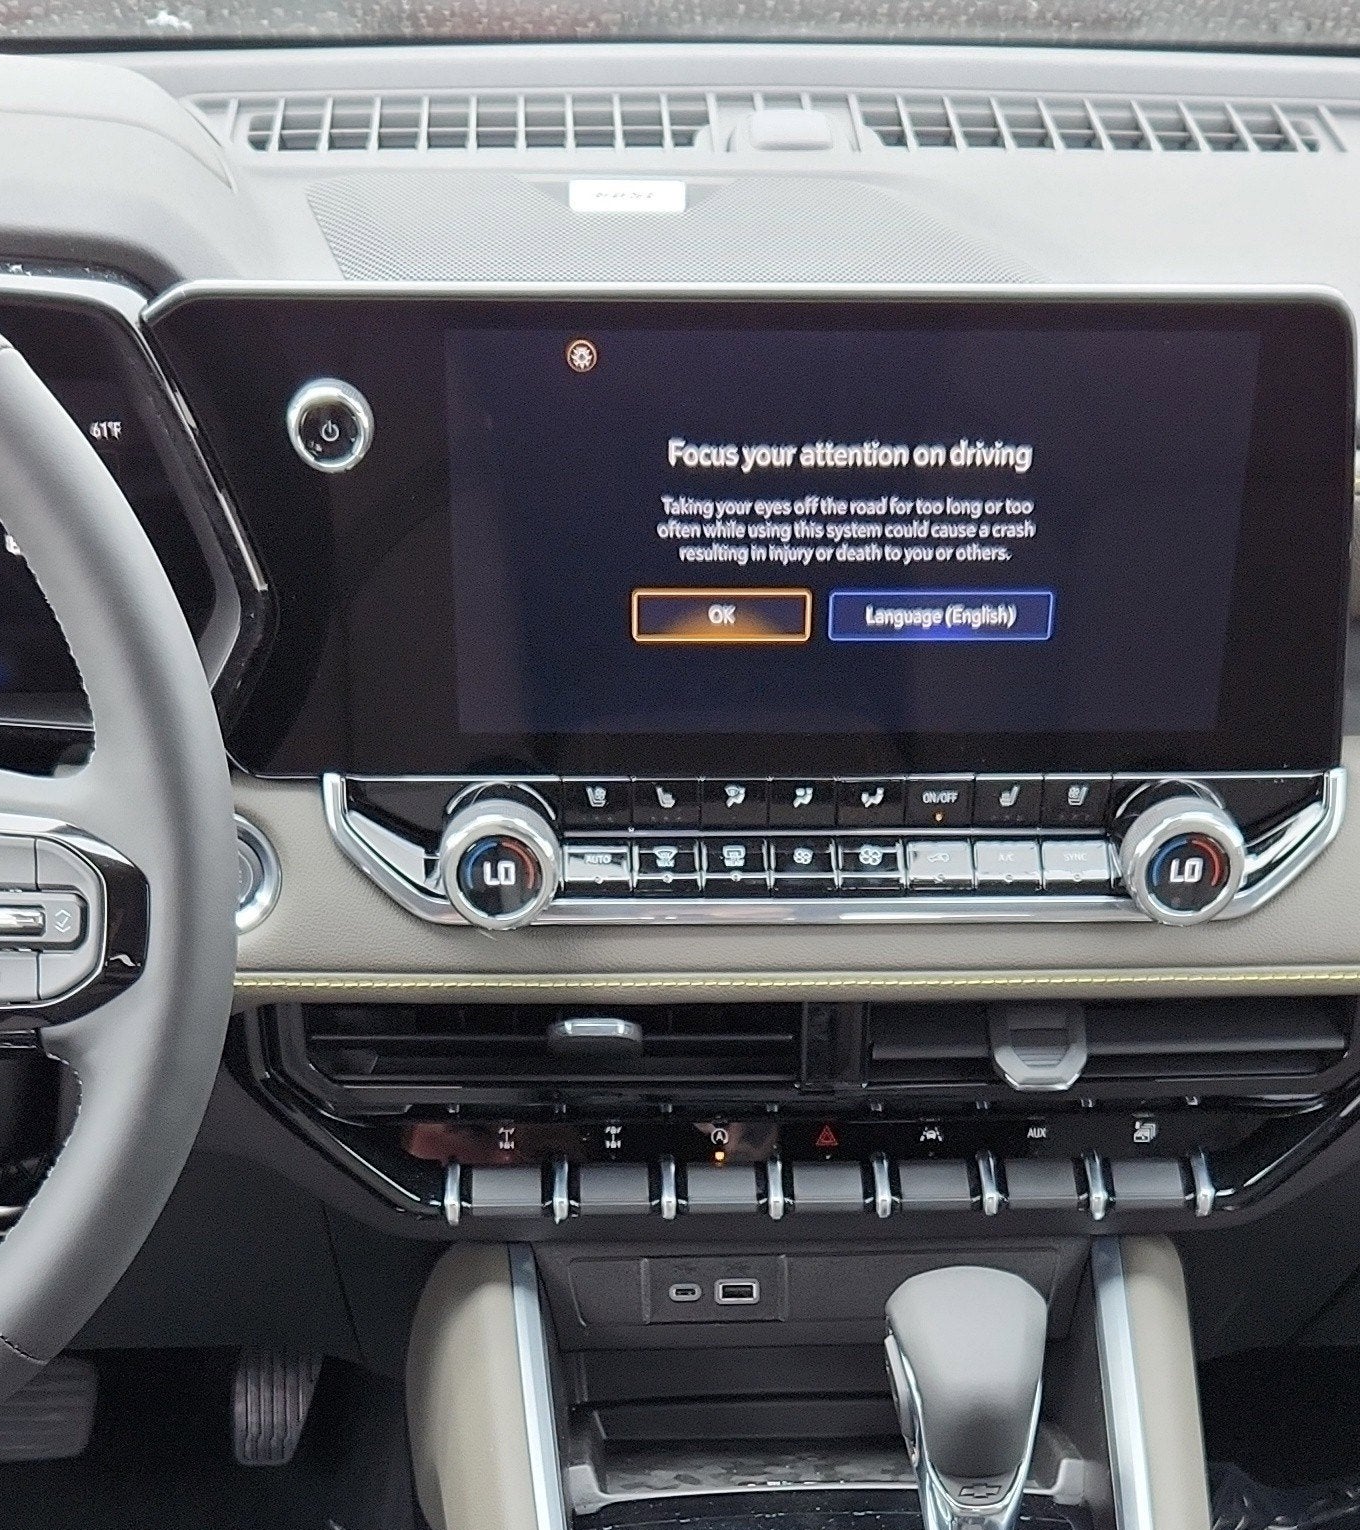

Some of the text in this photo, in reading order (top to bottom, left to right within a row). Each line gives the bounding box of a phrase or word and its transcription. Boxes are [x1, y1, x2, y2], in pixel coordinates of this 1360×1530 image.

[668, 437, 1033, 474] Focus your attention on driving
[661, 495, 1035, 519] Taking your eyes off the road for too long or too
[657, 518, 1037, 542] often while using this system could cause a crash
[679, 543, 1013, 566] resulting in injury or death to you or others.
[708, 604, 736, 625] OK
[865, 604, 1017, 629] Language (English)
[922, 791, 958, 805] ON/OFF
[584, 854, 612, 865] AUTO
[1062, 850, 1089, 862] SYNC
[1169, 856, 1204, 884] LO
[1027, 1126, 1047, 1139] AUX
